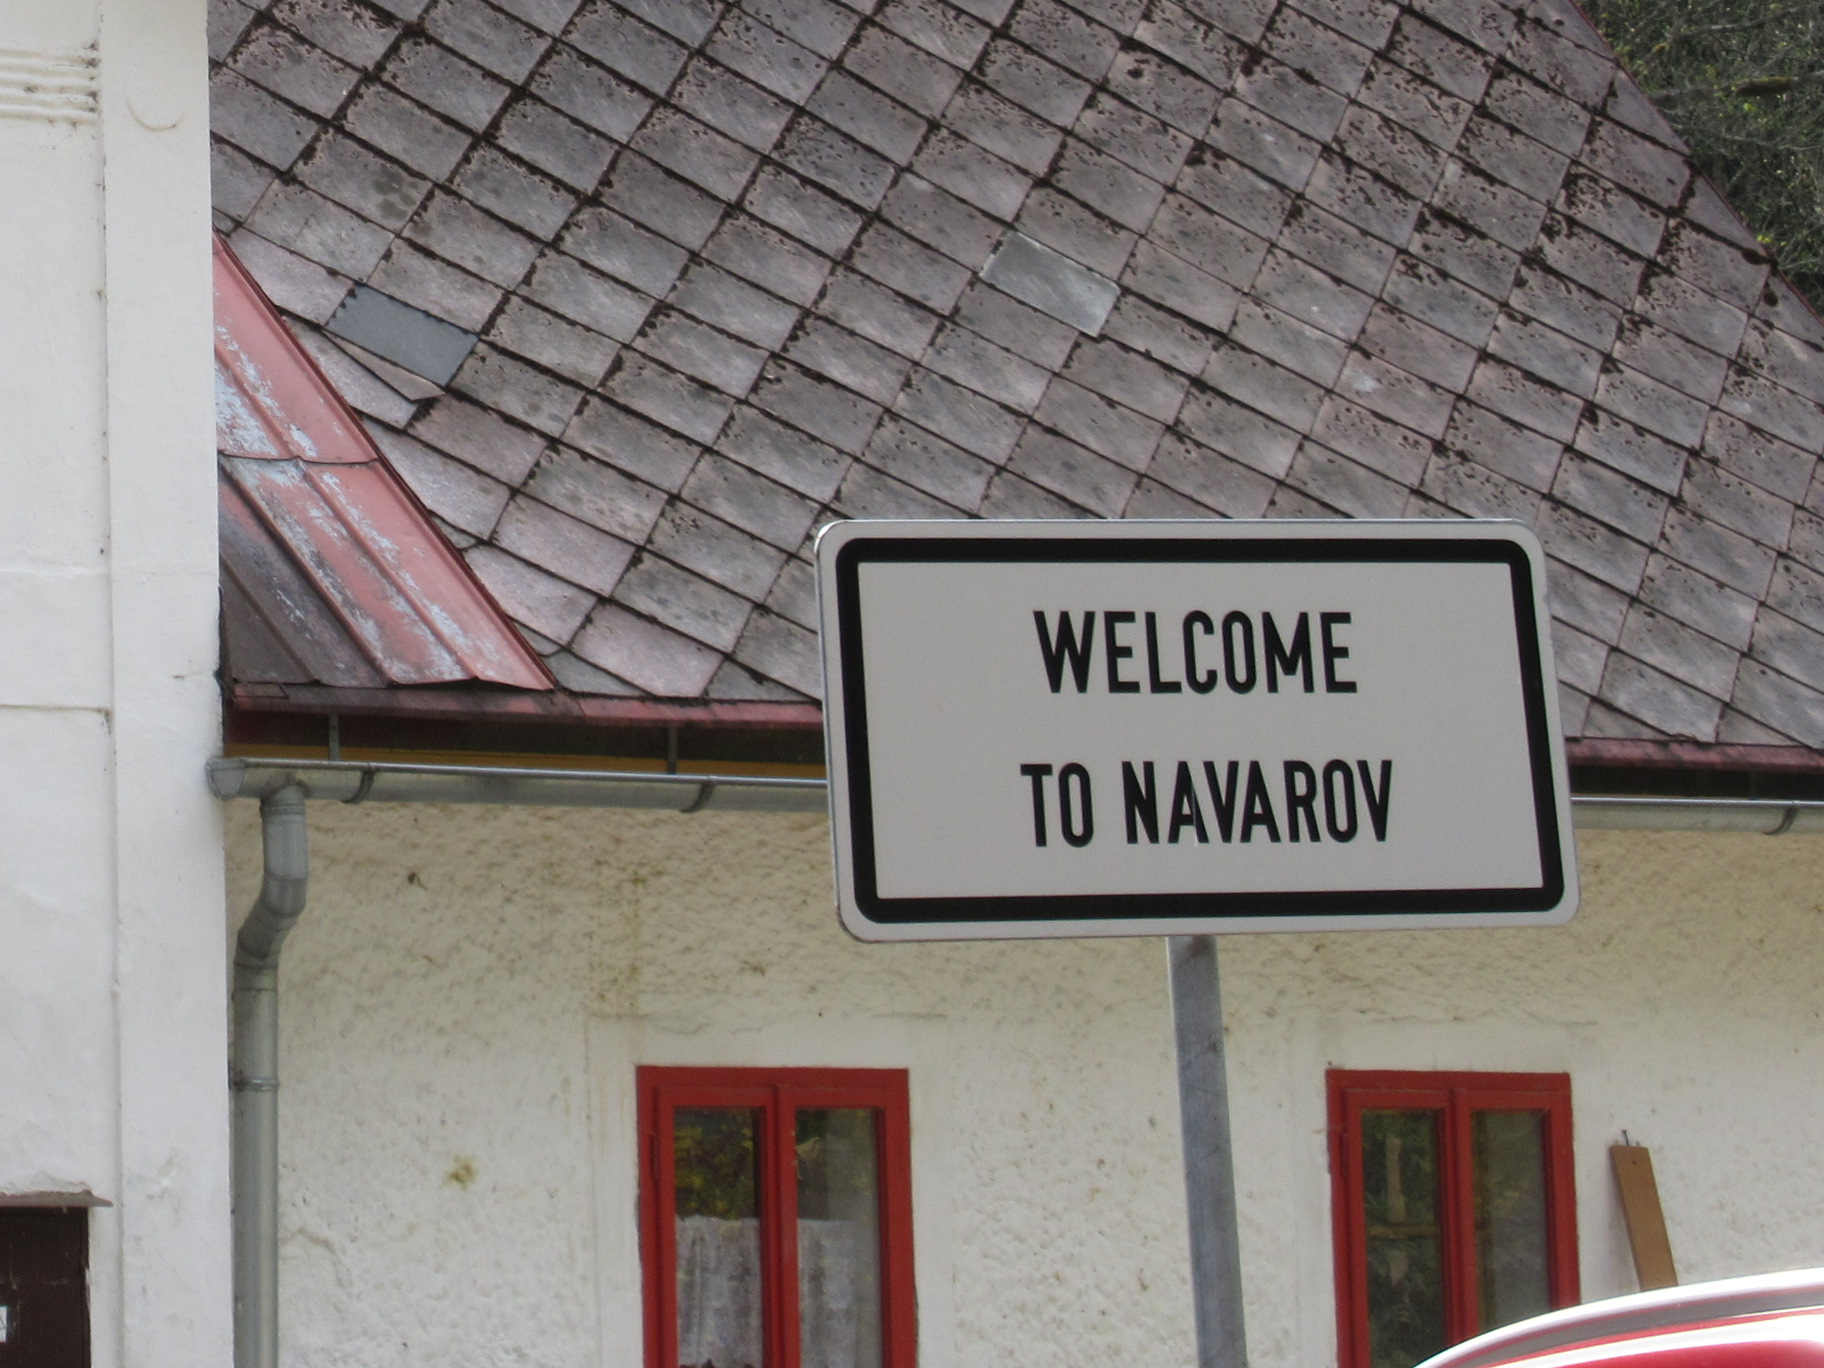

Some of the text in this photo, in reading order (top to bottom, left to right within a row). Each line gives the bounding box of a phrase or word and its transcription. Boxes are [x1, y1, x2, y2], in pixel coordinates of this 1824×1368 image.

[1032, 609, 1358, 695] WELCOME
[1020, 758, 1393, 848] TO NAVAROV
